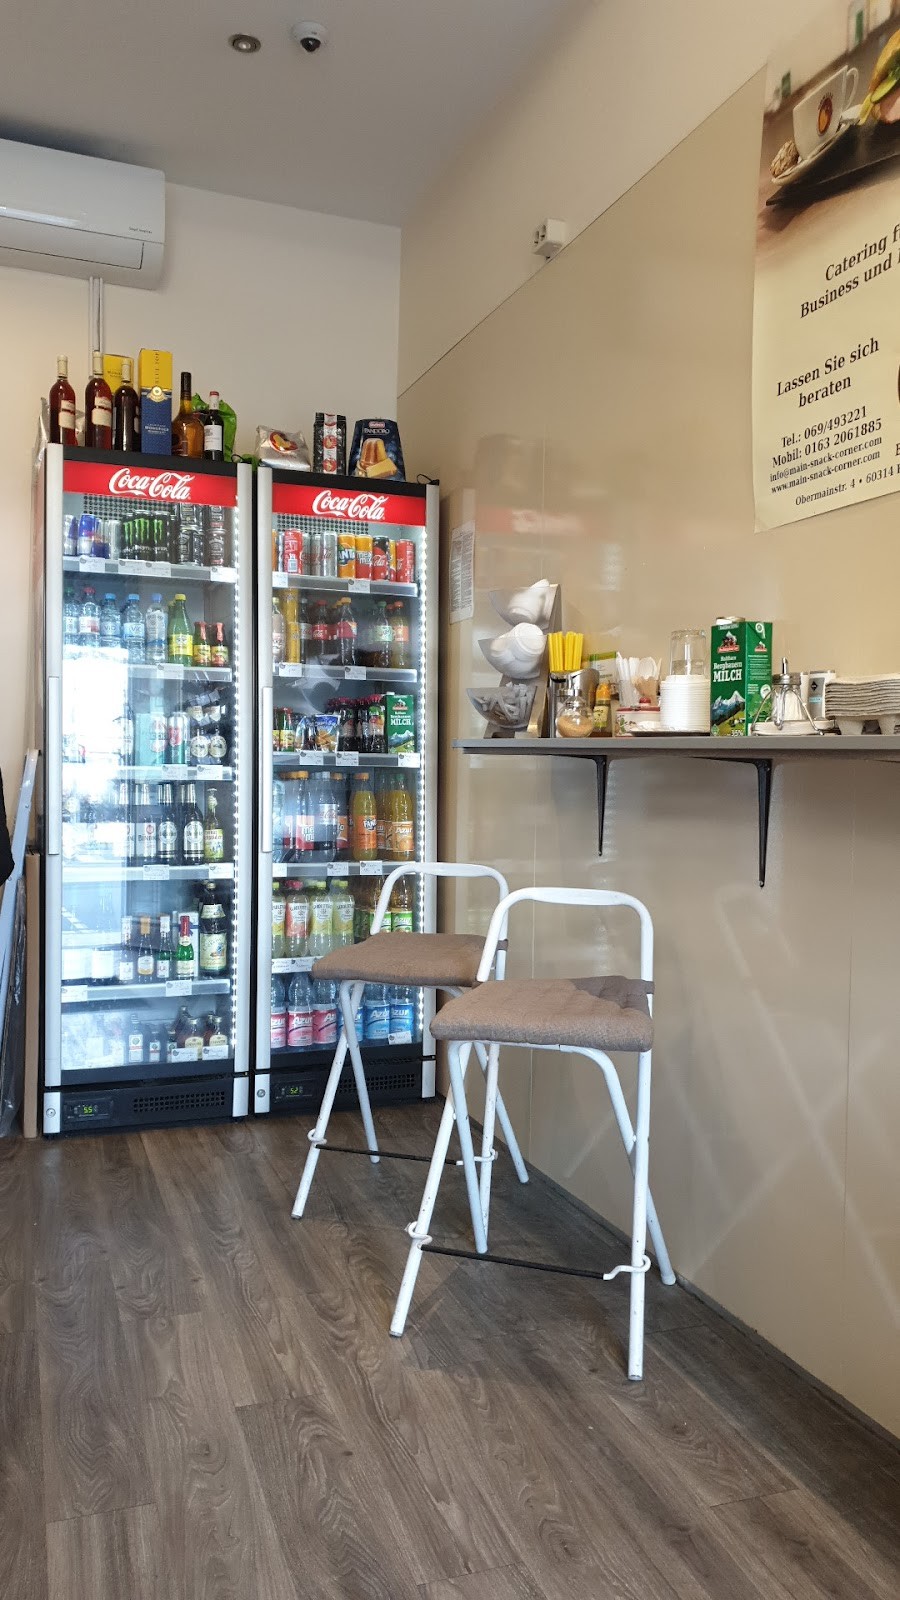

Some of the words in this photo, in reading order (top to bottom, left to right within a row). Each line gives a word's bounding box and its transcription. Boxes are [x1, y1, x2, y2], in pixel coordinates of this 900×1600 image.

[825, 235, 888, 281] Catering
[893, 223, 900, 243] f
[800, 275, 859, 319] Business
[863, 252, 892, 282] und
[776, 368, 820, 397] Lassen
[824, 355, 845, 375] Sie
[849, 337, 880, 363] sich
[798, 376, 851, 408] beraten
[771, 448, 802, 468] Mobil:
[804, 437, 830, 456] 0163
[833, 418, 882, 446] 2061885
[781, 433, 801, 448] Tel.:
[804, 405, 867, 440] 069/493221
[769, 436, 882, 482] info@main-snack-corner.com
[771, 450, 880, 493] www.main-snack-corner.com
[108, 467, 196, 500] Coca-Cola
[312, 489, 390, 520] Coca-Cola
[795, 482, 848, 506] Obermainstr.
[850, 478, 856, 489] 4
[866, 465, 895, 484] 60314
[713, 669, 743, 683] MILCH
[390, 718, 412, 726] MILCH
[293, 1016, 312, 1026] Azur
